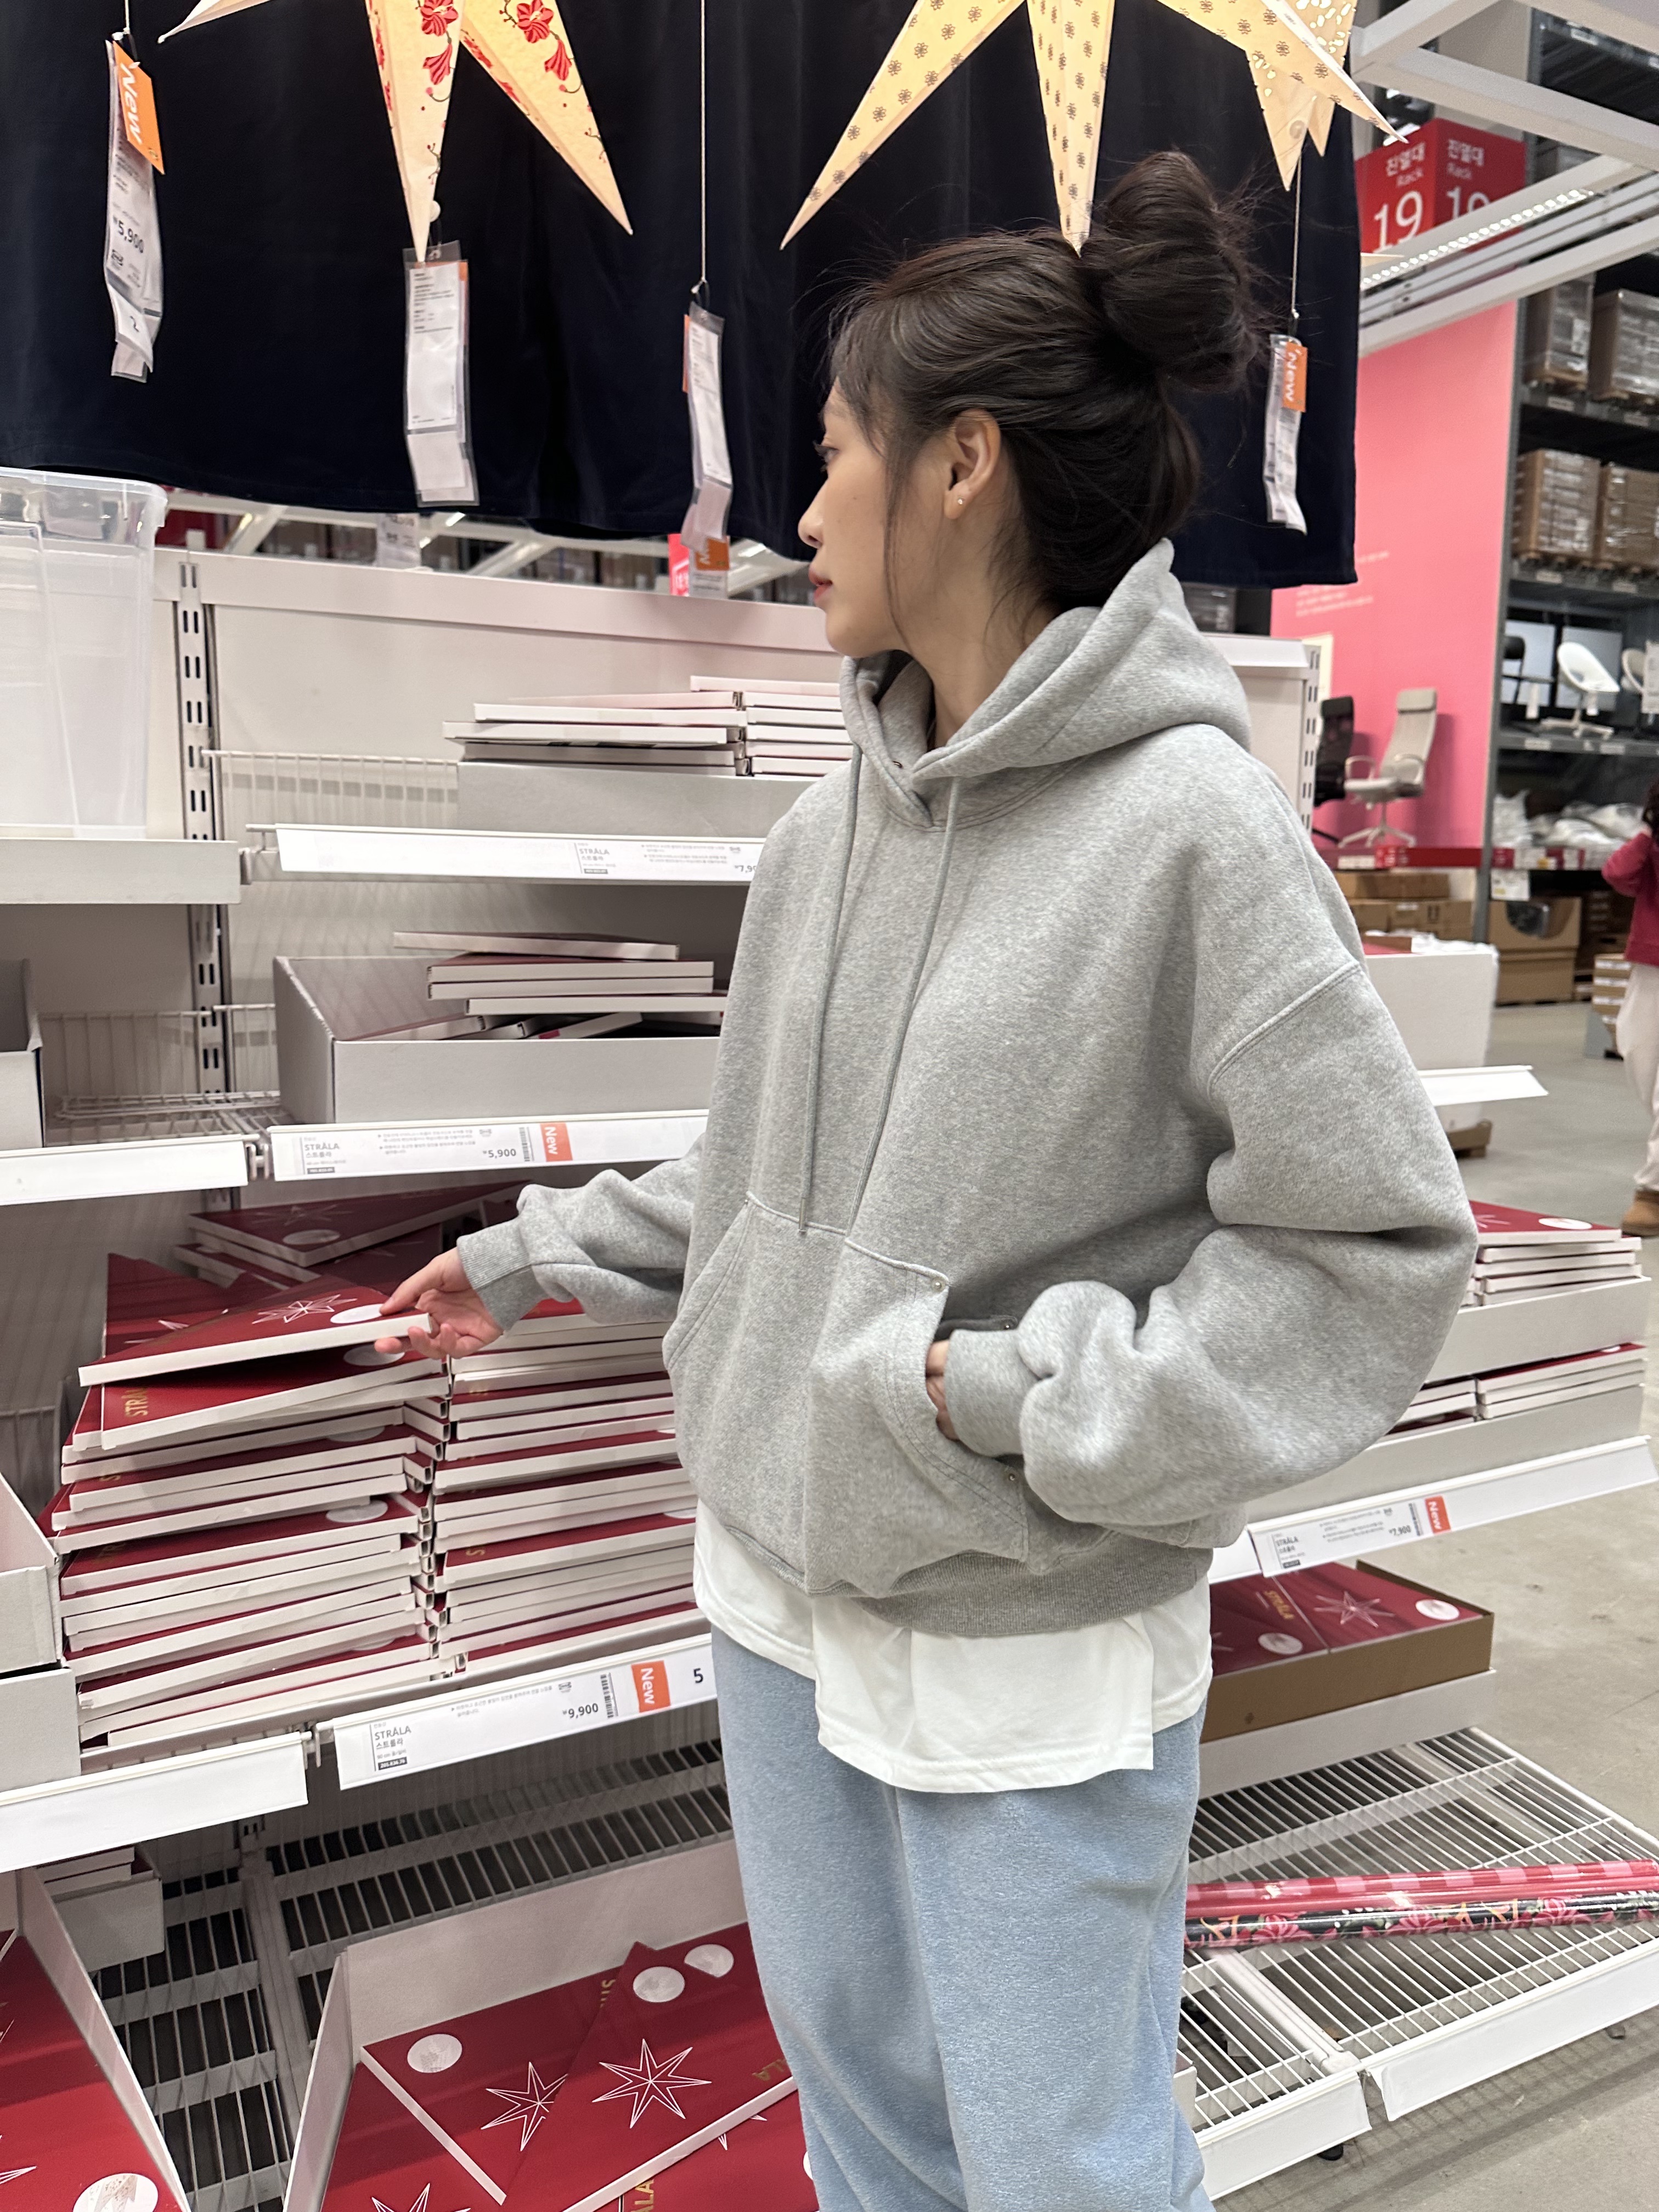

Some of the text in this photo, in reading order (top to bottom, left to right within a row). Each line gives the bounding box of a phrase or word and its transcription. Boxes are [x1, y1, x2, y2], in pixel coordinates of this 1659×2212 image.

[120, 63, 143, 145] New
[1374, 190, 1423, 253] 19
[544, 1126, 557, 1155] New
[1428, 1501, 1442, 1530] New
[641, 1667, 655, 1705] New
[693, 1668, 703, 1684] 5
[376, 1738, 403, 1750] 스트롤라
